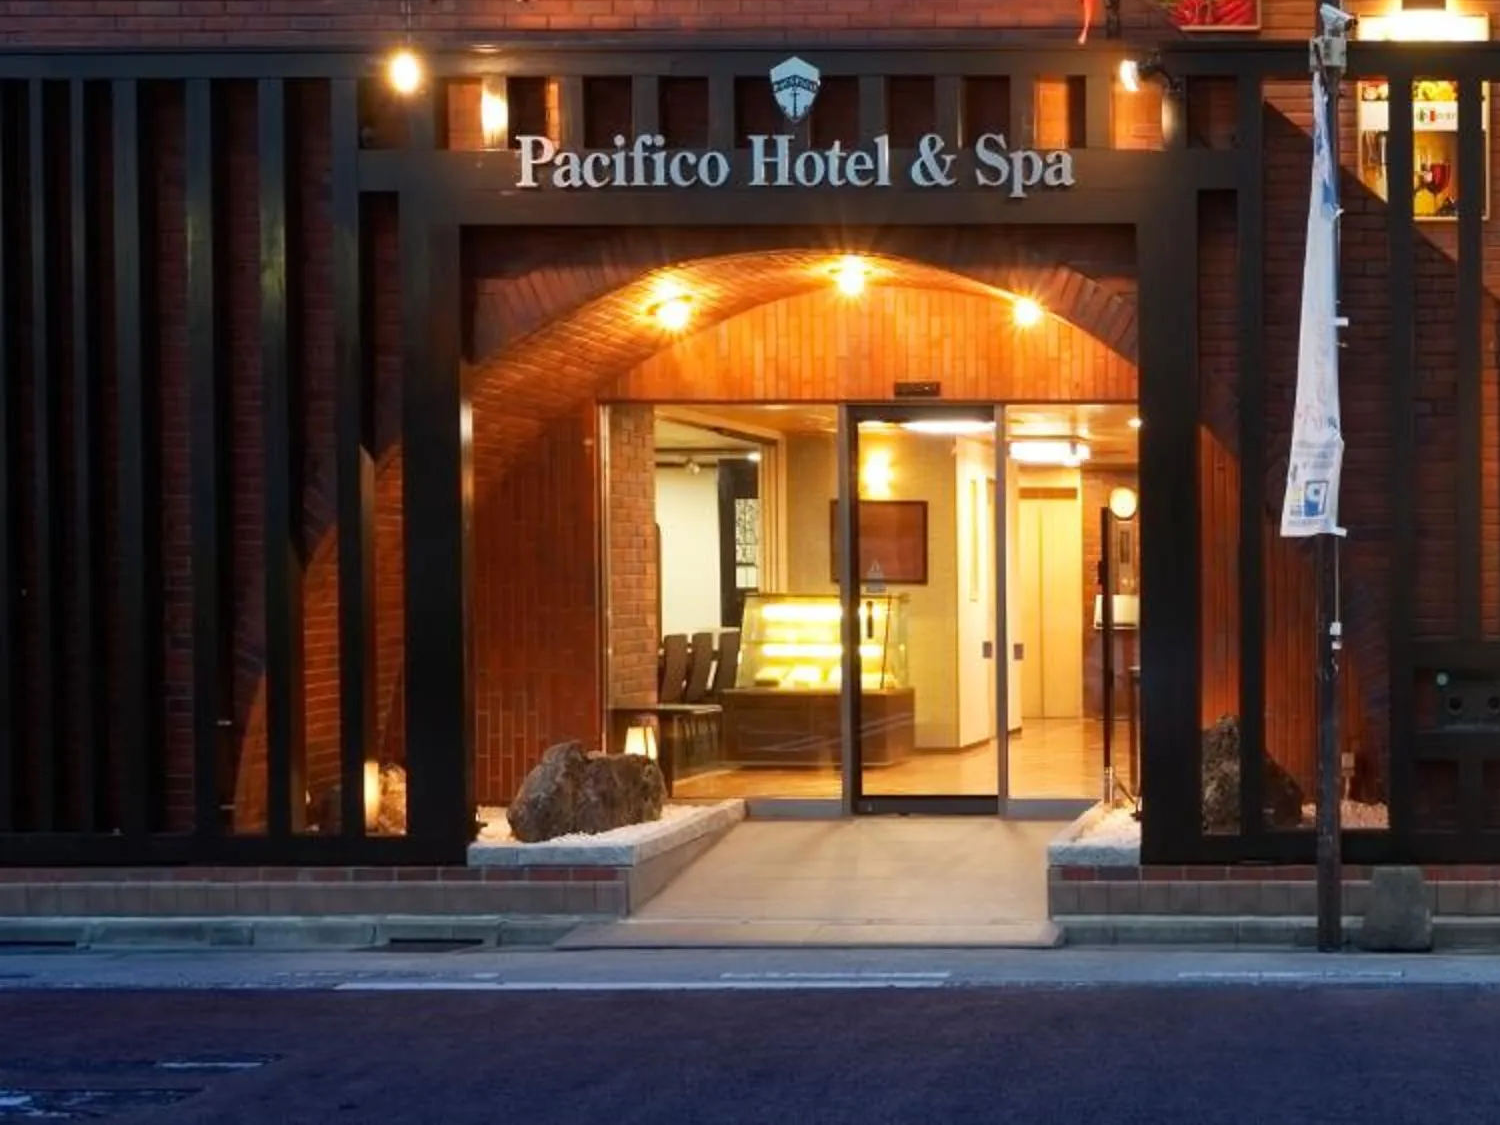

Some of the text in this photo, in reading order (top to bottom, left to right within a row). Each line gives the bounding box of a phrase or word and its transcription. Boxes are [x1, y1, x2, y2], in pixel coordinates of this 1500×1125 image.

[514, 133, 1076, 198] Pacifico Hotel & Spa
